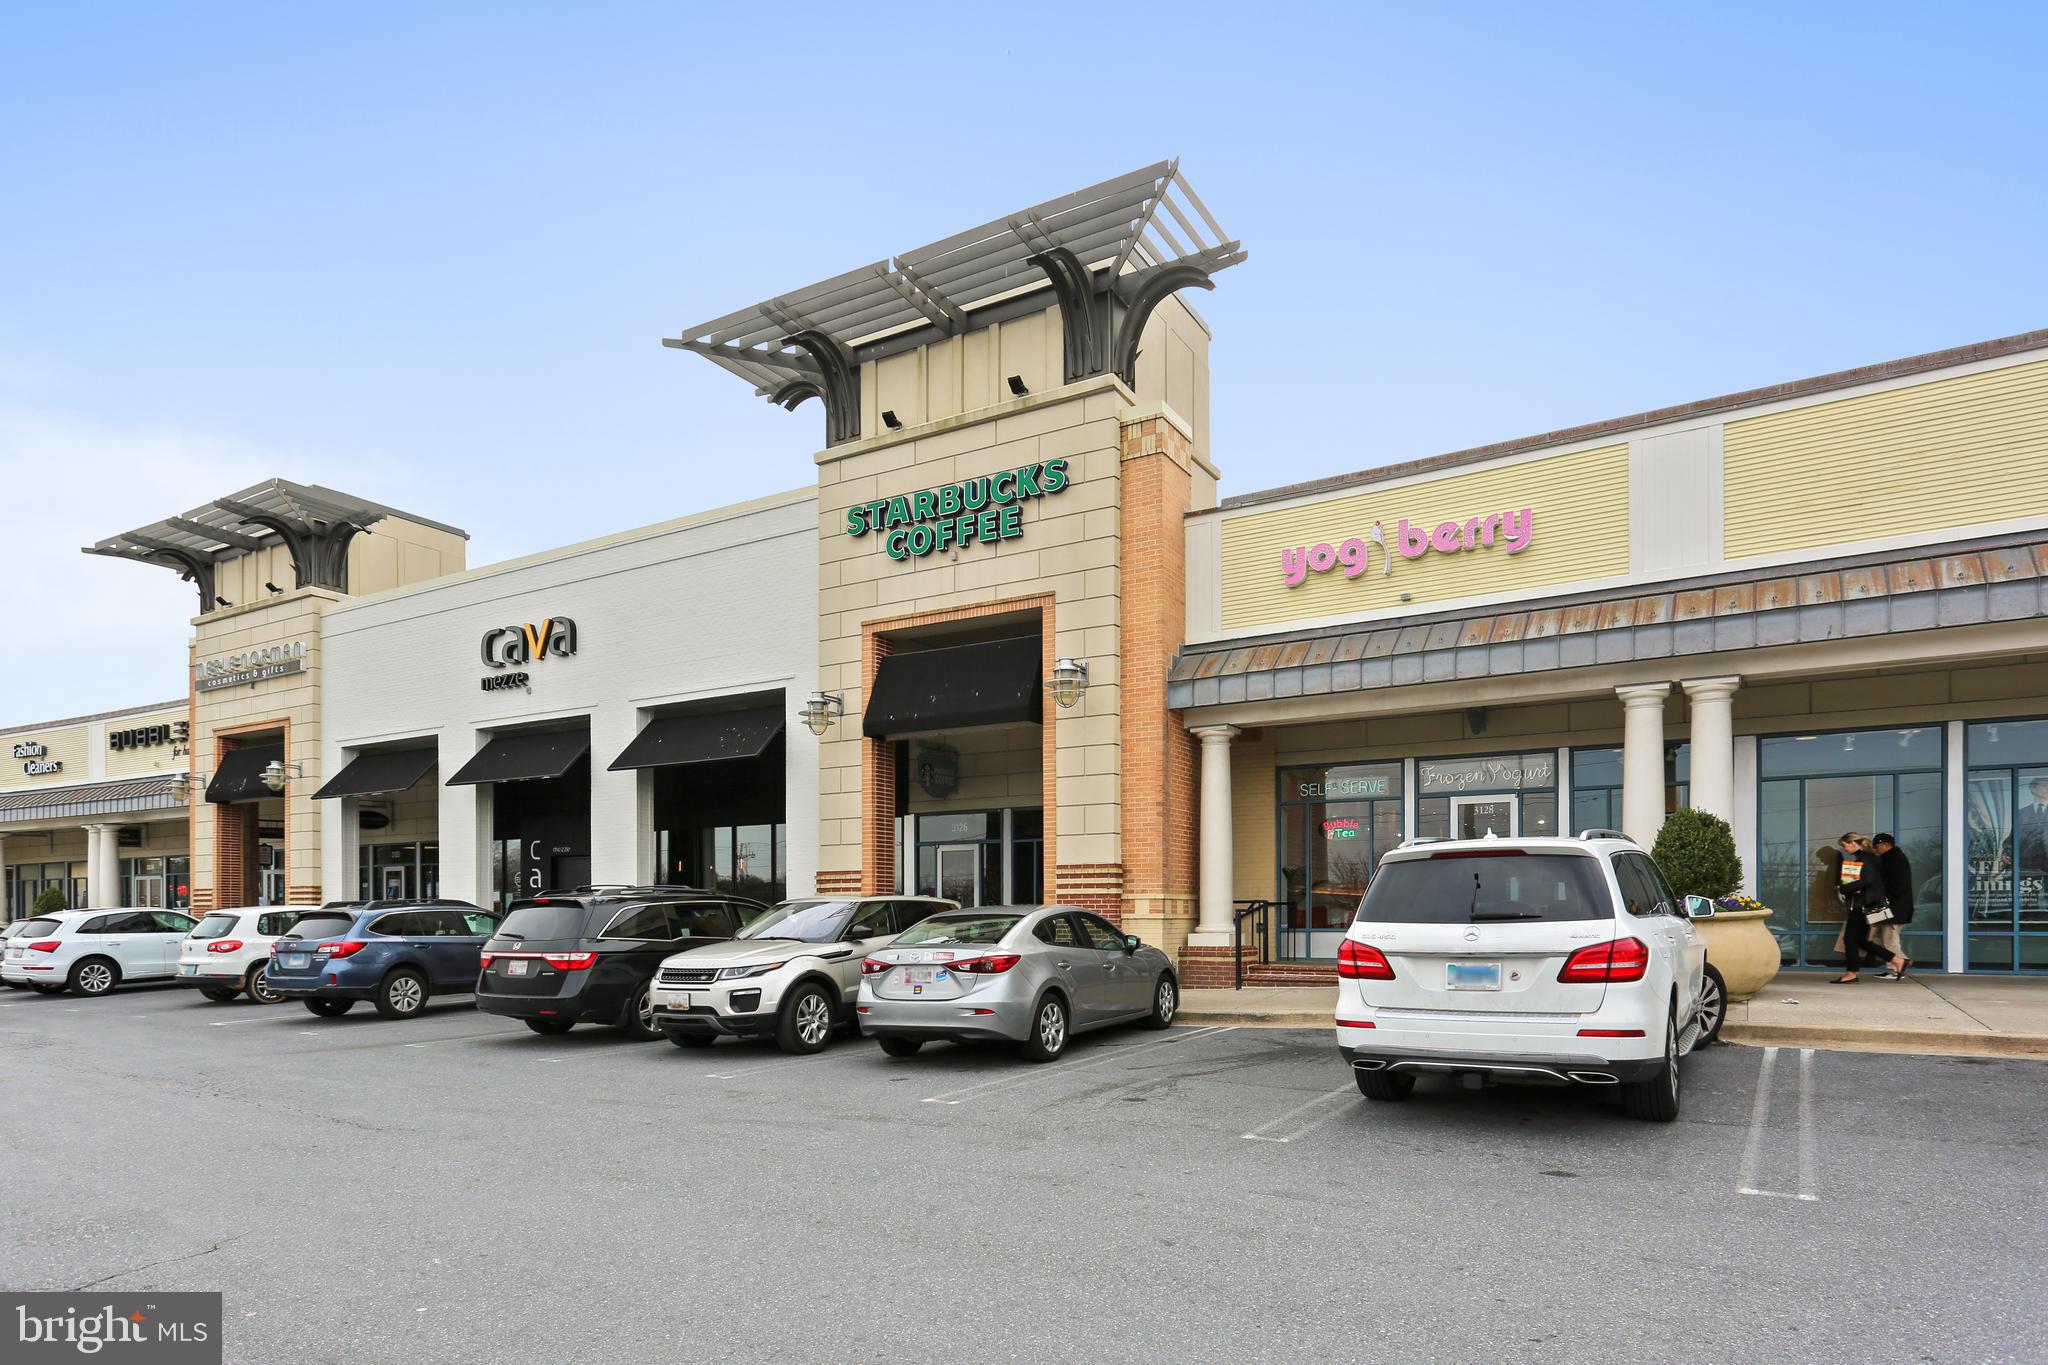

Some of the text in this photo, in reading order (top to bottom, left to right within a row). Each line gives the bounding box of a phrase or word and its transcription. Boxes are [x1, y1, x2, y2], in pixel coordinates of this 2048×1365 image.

[847, 458, 1070, 537] STARBUCKS
[885, 504, 1024, 561] COFFEE
[1397, 508, 1533, 560] berry
[481, 616, 577, 668] cava
[207, 665, 284, 687] cosmetics & gifts
[481, 672, 530, 691] mezze
[109, 720, 190, 751] BUBBLE
[12, 740, 44, 759] Fashion
[172, 746, 182, 761] for
[22, 760, 59, 776] Cleaners
[1420, 761, 1551, 791] Frozen Yogurt
[1473, 805, 1495, 816] 3128
[1323, 818, 1359, 831] Bubble
[1334, 828, 1356, 838] Tea
